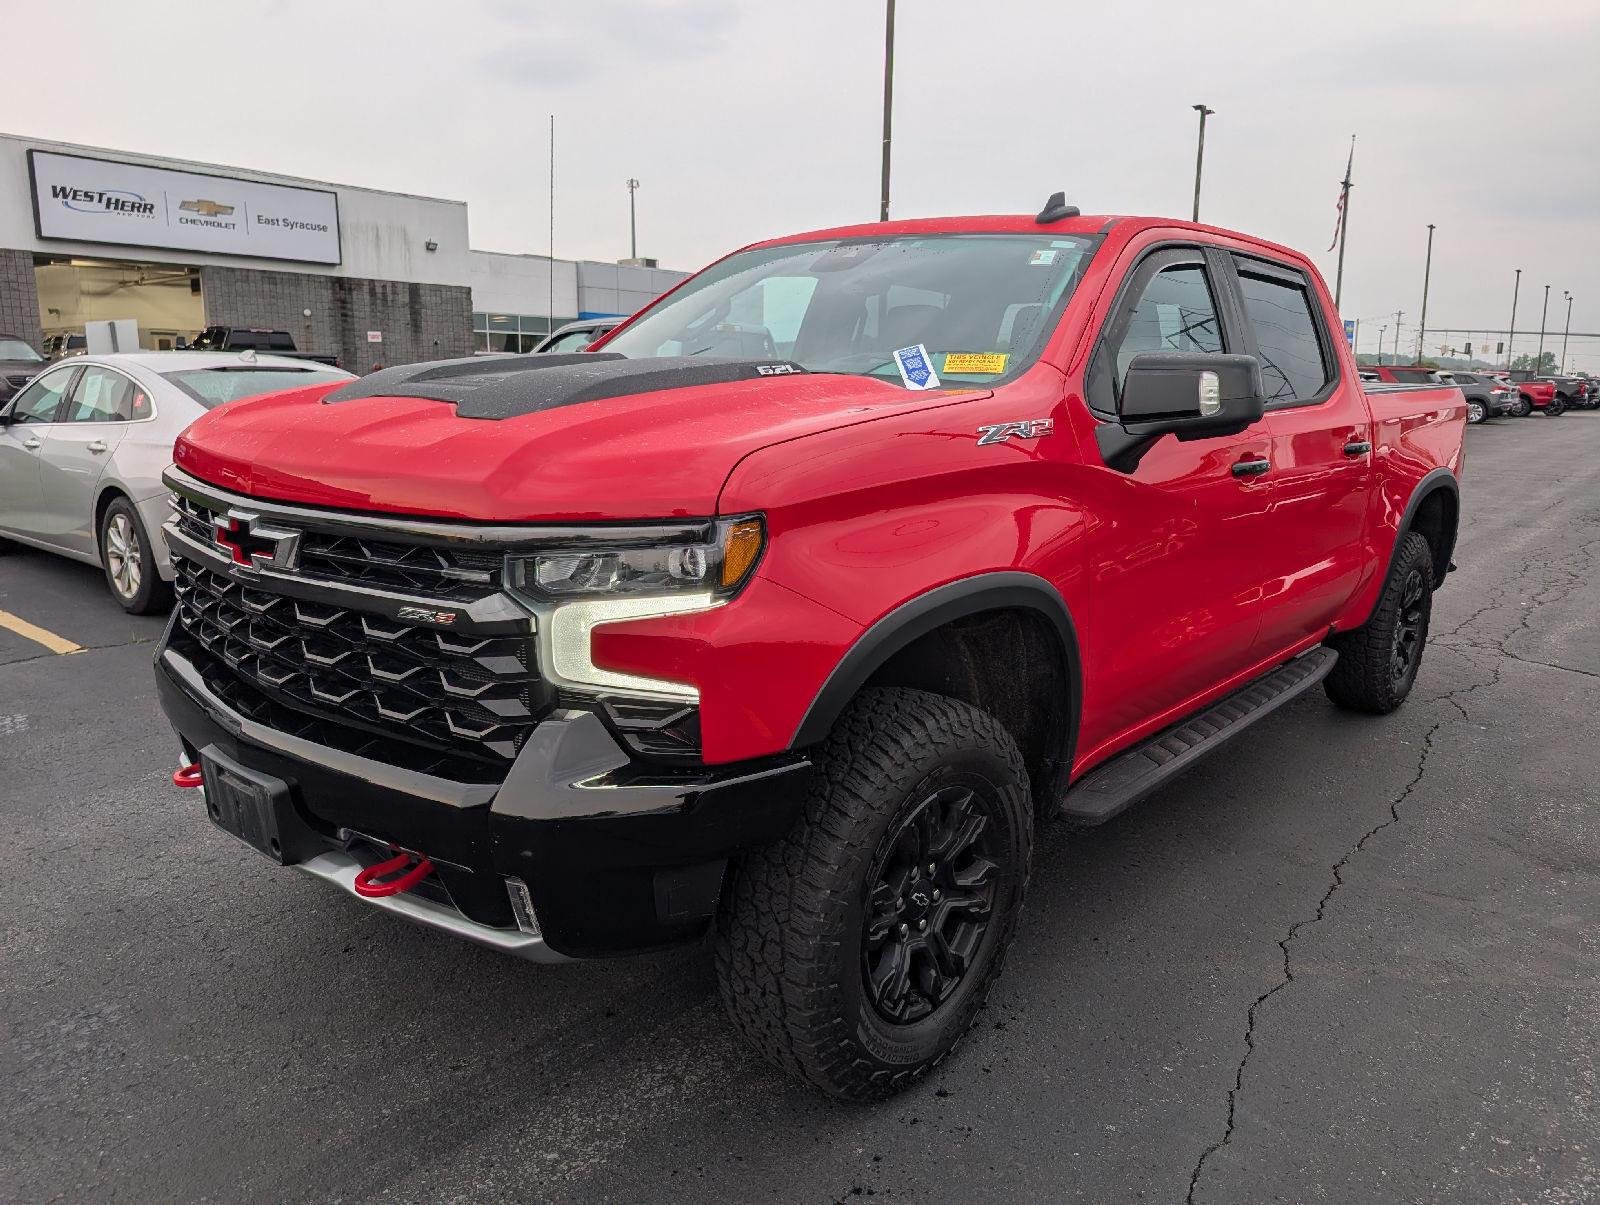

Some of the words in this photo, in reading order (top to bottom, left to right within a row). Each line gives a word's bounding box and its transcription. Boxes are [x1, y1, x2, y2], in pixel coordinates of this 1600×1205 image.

[51, 185, 107, 203] WEST
[105, 197, 155, 214] HERR
[178, 217, 237, 230] CHEVROLET
[257, 214, 280, 226] East
[283, 218, 328, 232] Syracuse
[977, 419, 1053, 445] ZR2
